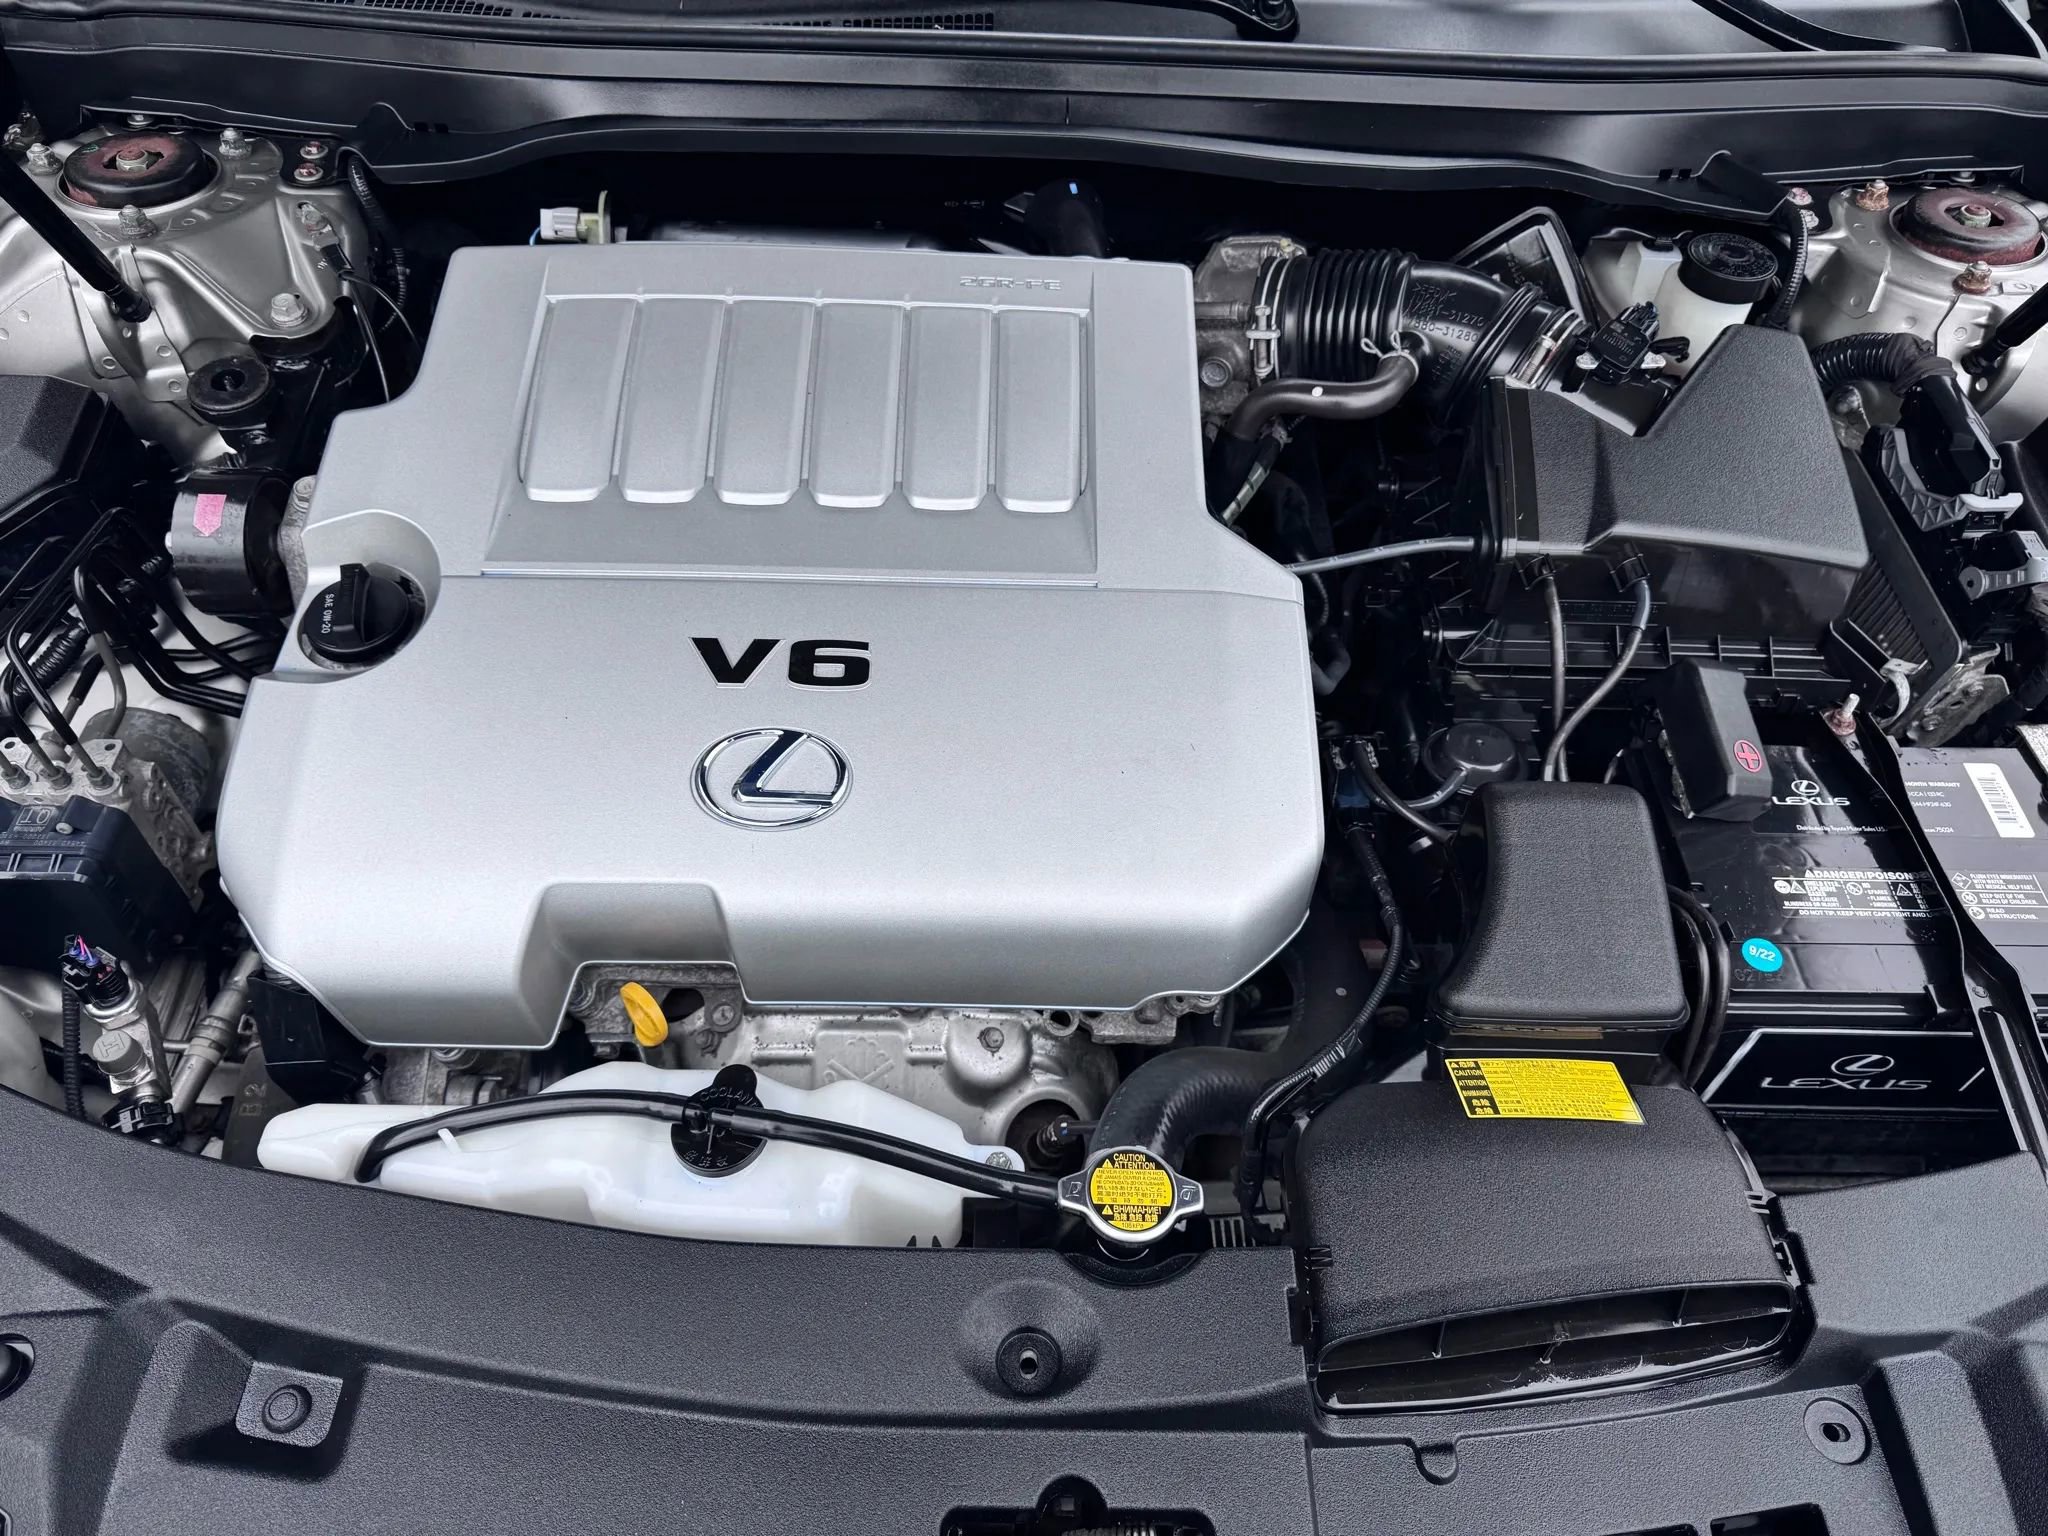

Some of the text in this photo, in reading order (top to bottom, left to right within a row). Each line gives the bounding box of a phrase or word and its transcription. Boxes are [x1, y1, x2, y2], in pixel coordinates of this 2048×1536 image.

[321, 594, 335, 634] SAE 0W-20
[689, 637, 871, 689] V6
[1772, 796, 1851, 806] LEXUS
[1814, 871, 1914, 880] DANGER/POISON
[1749, 945, 1776, 961] 9/22
[1454, 1069, 1483, 1077] CAUTION
[1459, 1079, 1488, 1087] ATTENTION
[1761, 1077, 1932, 1090] LEXUS
[1113, 1153, 1146, 1161] CAUTION
[1113, 1161, 1156, 1169] ATTENTION
[1113, 1205, 1162, 1215] ВНИМАНИЕ!
